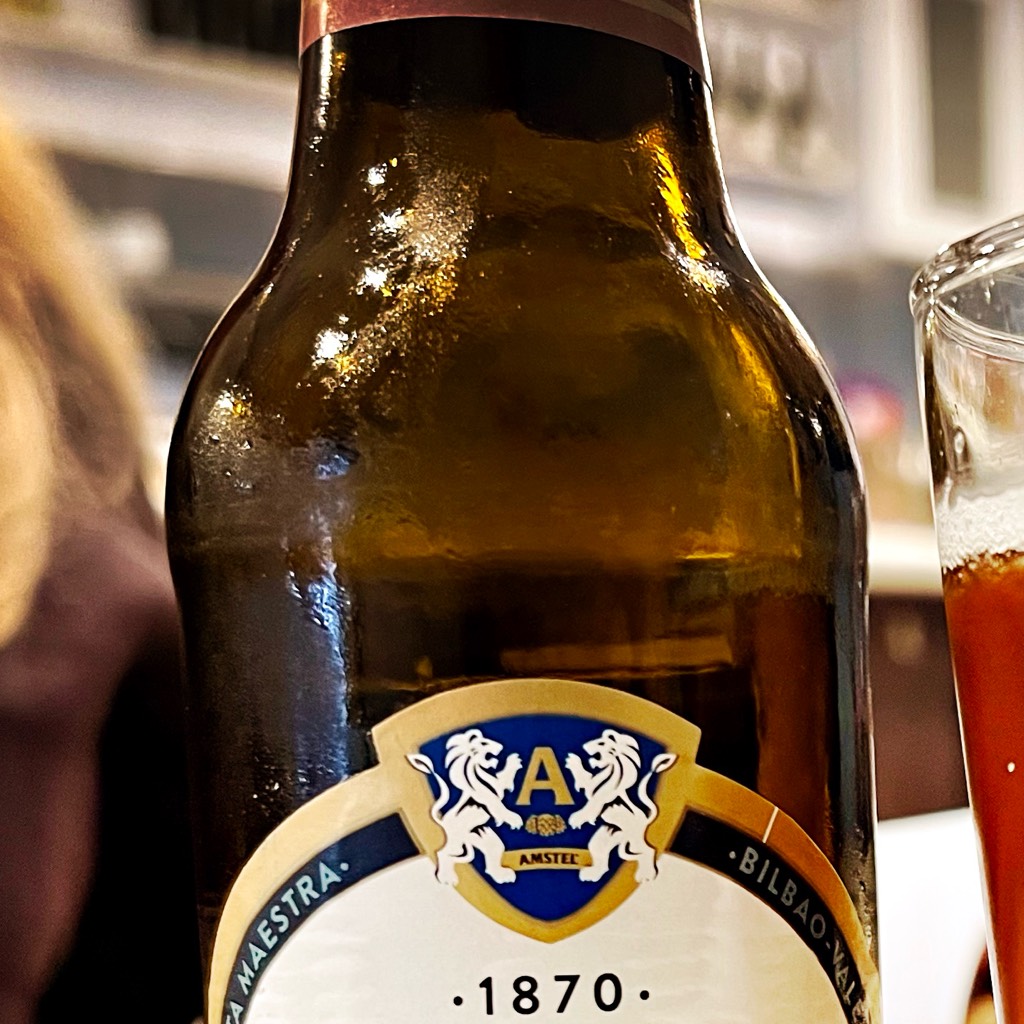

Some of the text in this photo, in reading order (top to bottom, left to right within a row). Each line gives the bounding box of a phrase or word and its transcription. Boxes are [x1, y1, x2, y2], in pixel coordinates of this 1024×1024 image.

[514, 746, 576, 806] A
[519, 852, 579, 866] AMSTEL
[738, 846, 827, 940] BILBAO
[236, 860, 342, 997] MAESTRA
[478, 973, 623, 1016] 1870
